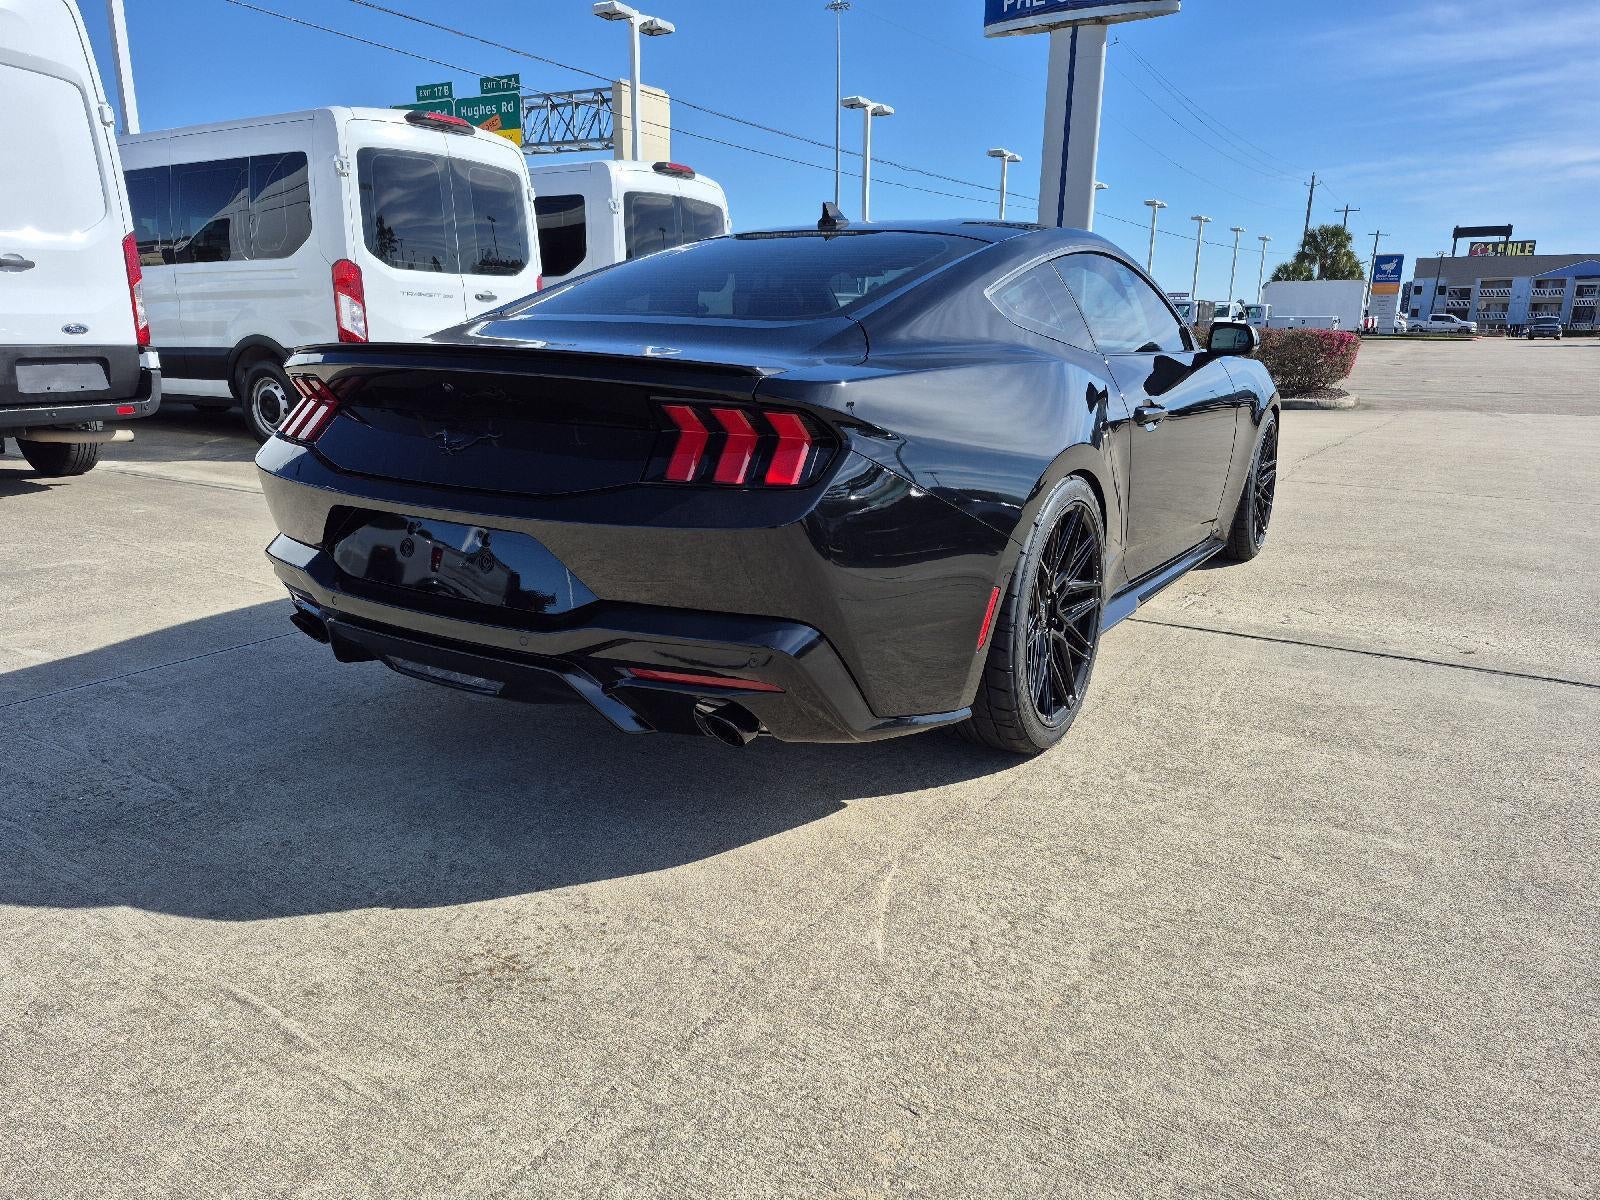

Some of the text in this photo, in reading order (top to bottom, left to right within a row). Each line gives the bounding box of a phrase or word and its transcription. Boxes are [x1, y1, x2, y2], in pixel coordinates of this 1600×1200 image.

[483, 81, 496, 90] EXIT
[419, 89, 431, 97] EXIT
[460, 101, 514, 118] Hughes Rd
